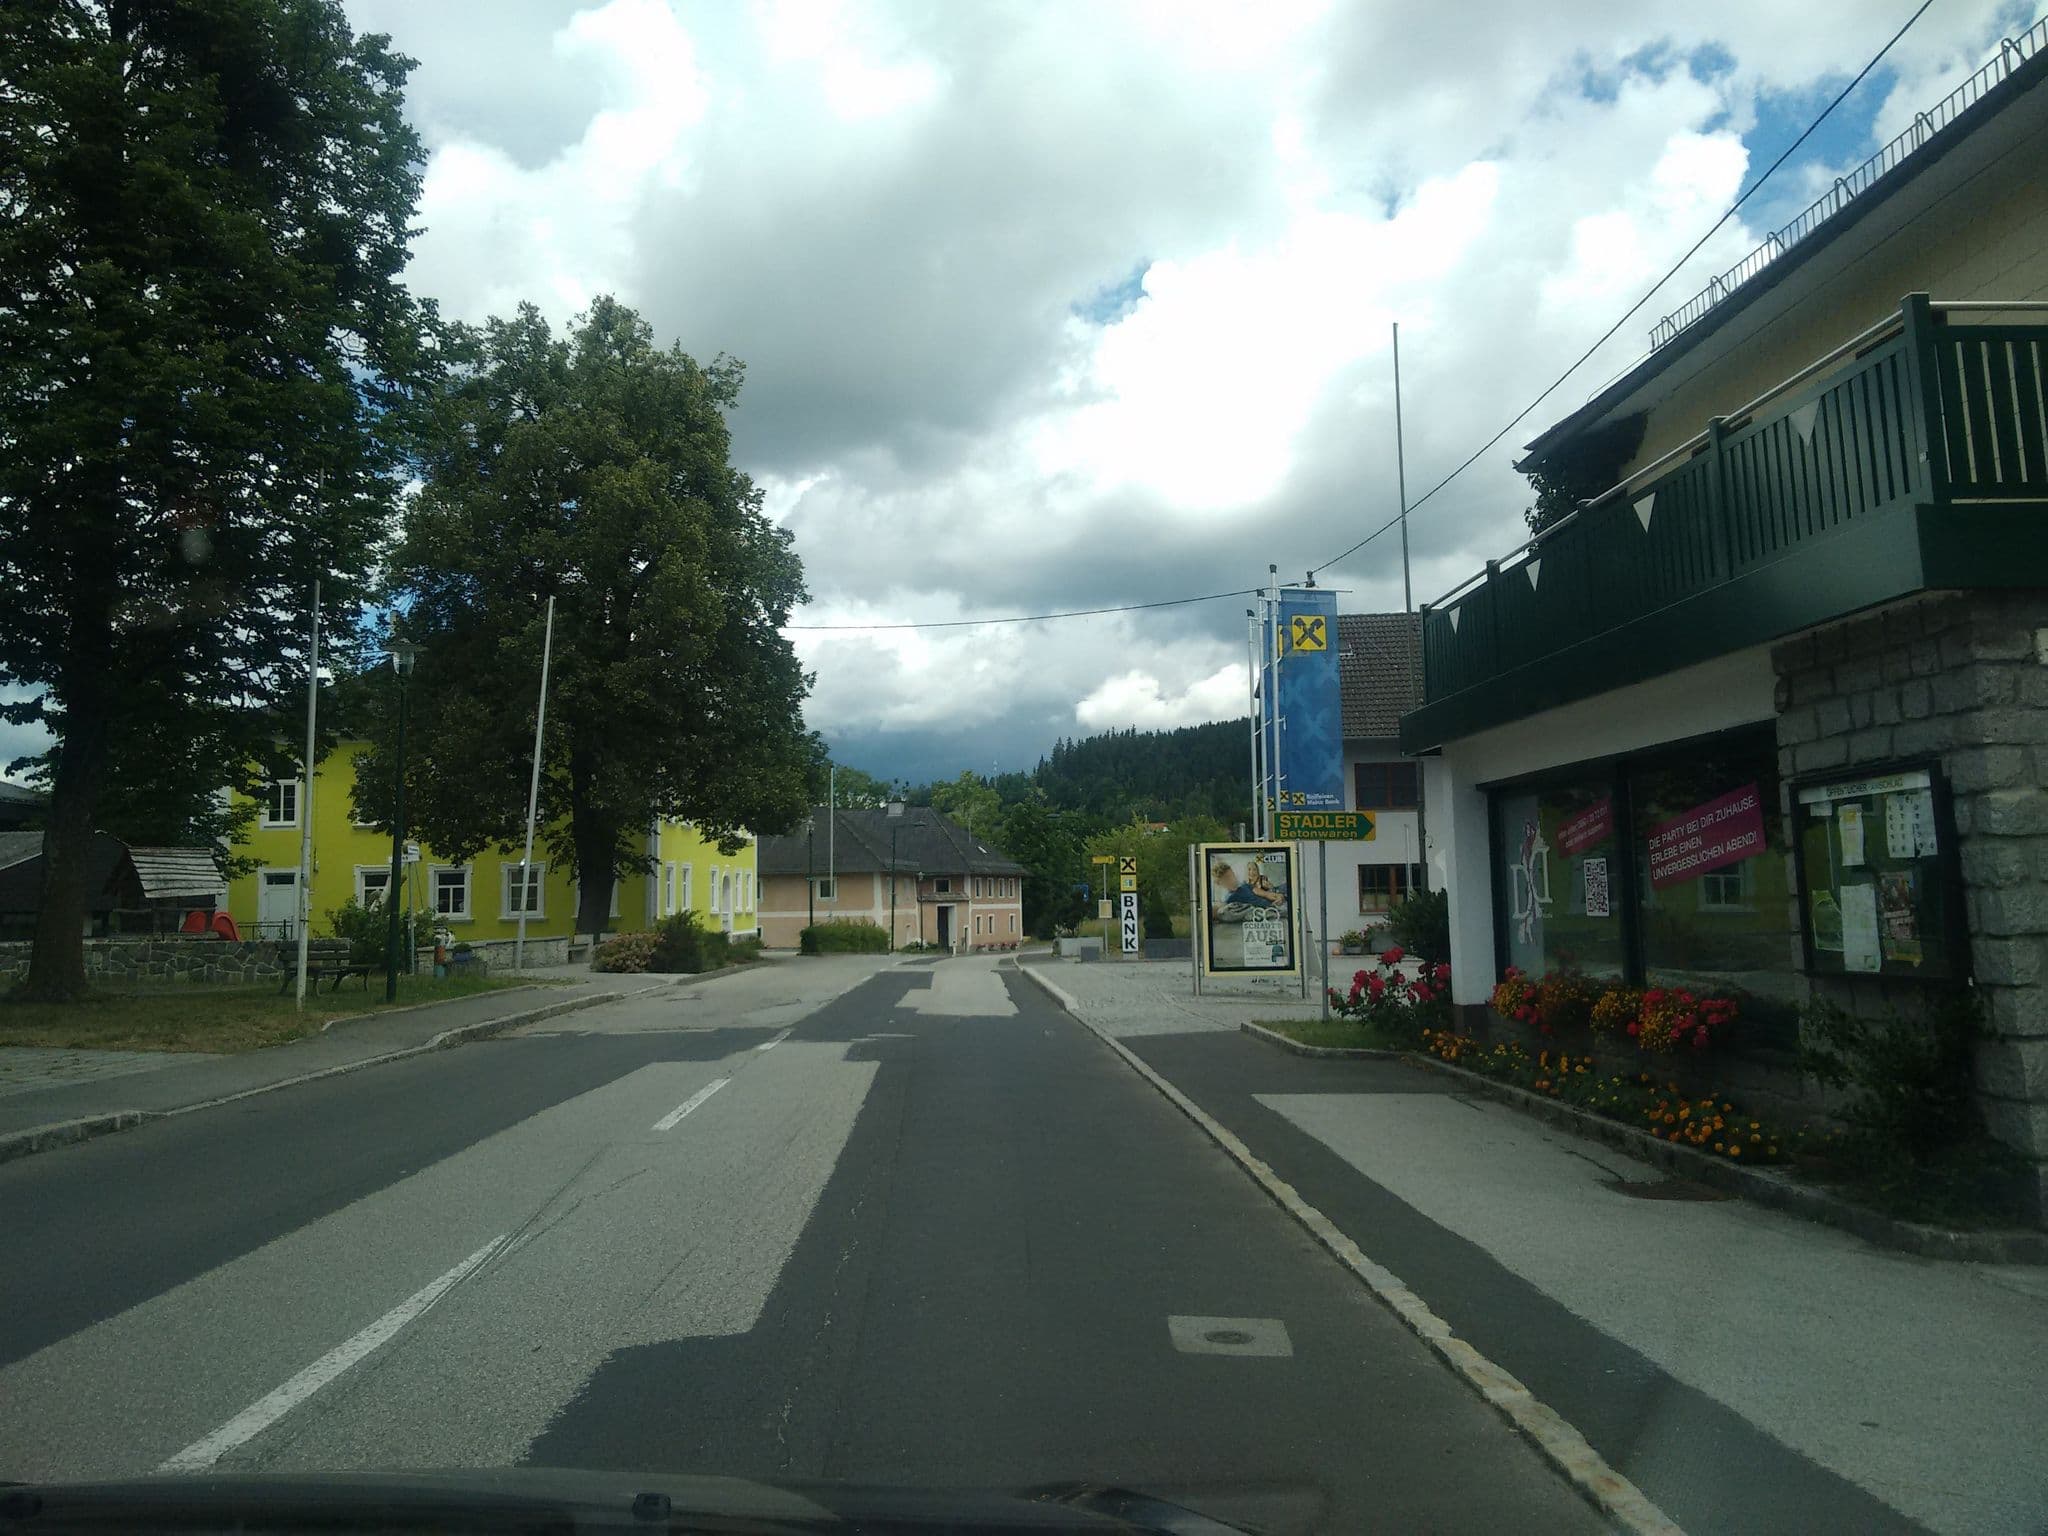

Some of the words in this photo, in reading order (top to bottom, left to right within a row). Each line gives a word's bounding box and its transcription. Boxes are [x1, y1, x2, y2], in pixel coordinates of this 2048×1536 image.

[1280, 815, 1357, 828] STADLER
[1649, 836, 1661, 849] DIE
[1662, 826, 1685, 845] PARTY
[1686, 819, 1699, 834] BEI
[1700, 813, 1714, 828] DIR
[1715, 795, 1757, 822] ZUHAUSE.
[1280, 828, 1357, 838] Betonwaren
[1651, 846, 1678, 864] ERLEBE
[1679, 835, 1702, 853] EINEN
[1652, 844, 1725, 880] UNVERGESSLICHEN
[1726, 831, 1758, 852] ABEND!
[1123, 895, 1136, 949] BANK
[1253, 907, 1280, 923] SO
[1245, 930, 1283, 943] AUS!
